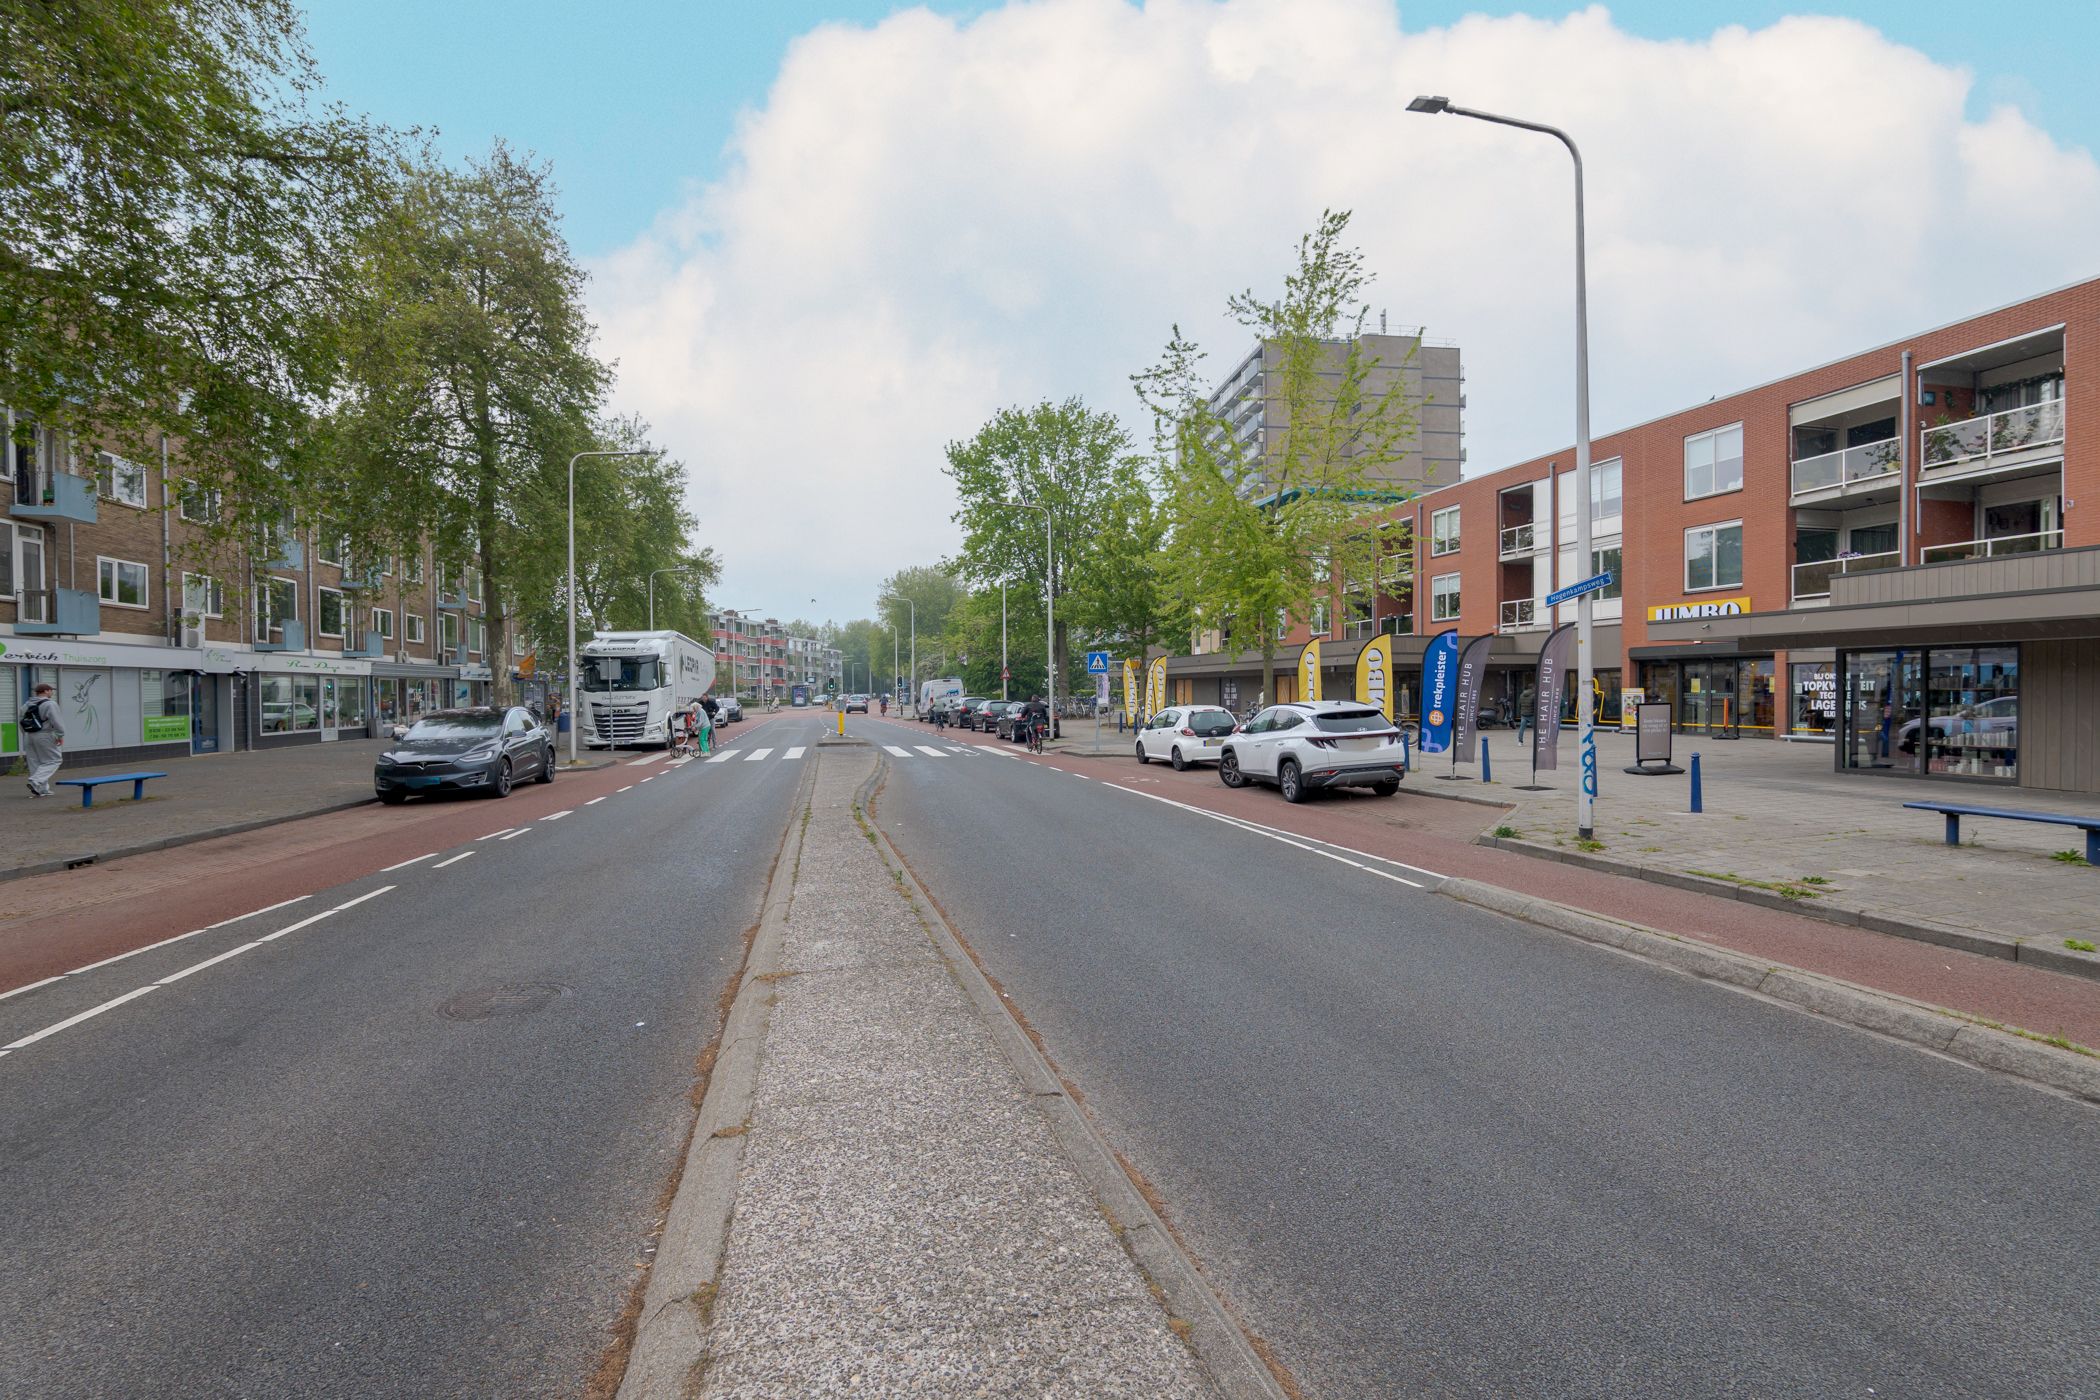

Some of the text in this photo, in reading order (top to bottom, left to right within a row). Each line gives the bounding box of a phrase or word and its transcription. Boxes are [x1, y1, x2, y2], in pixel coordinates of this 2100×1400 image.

[1550, 578, 1605, 602] Hogenkampsweg
[1655, 602, 1741, 620] JUMBO
[63, 653, 107, 664] Thuiszorg
[1366, 648, 1383, 712] MBO
[1433, 650, 1447, 708] trekpleister
[1462, 663, 1472, 686] HUB
[1459, 692, 1468, 719] HAIR
[1538, 658, 1552, 752] THE HAIR HUB
